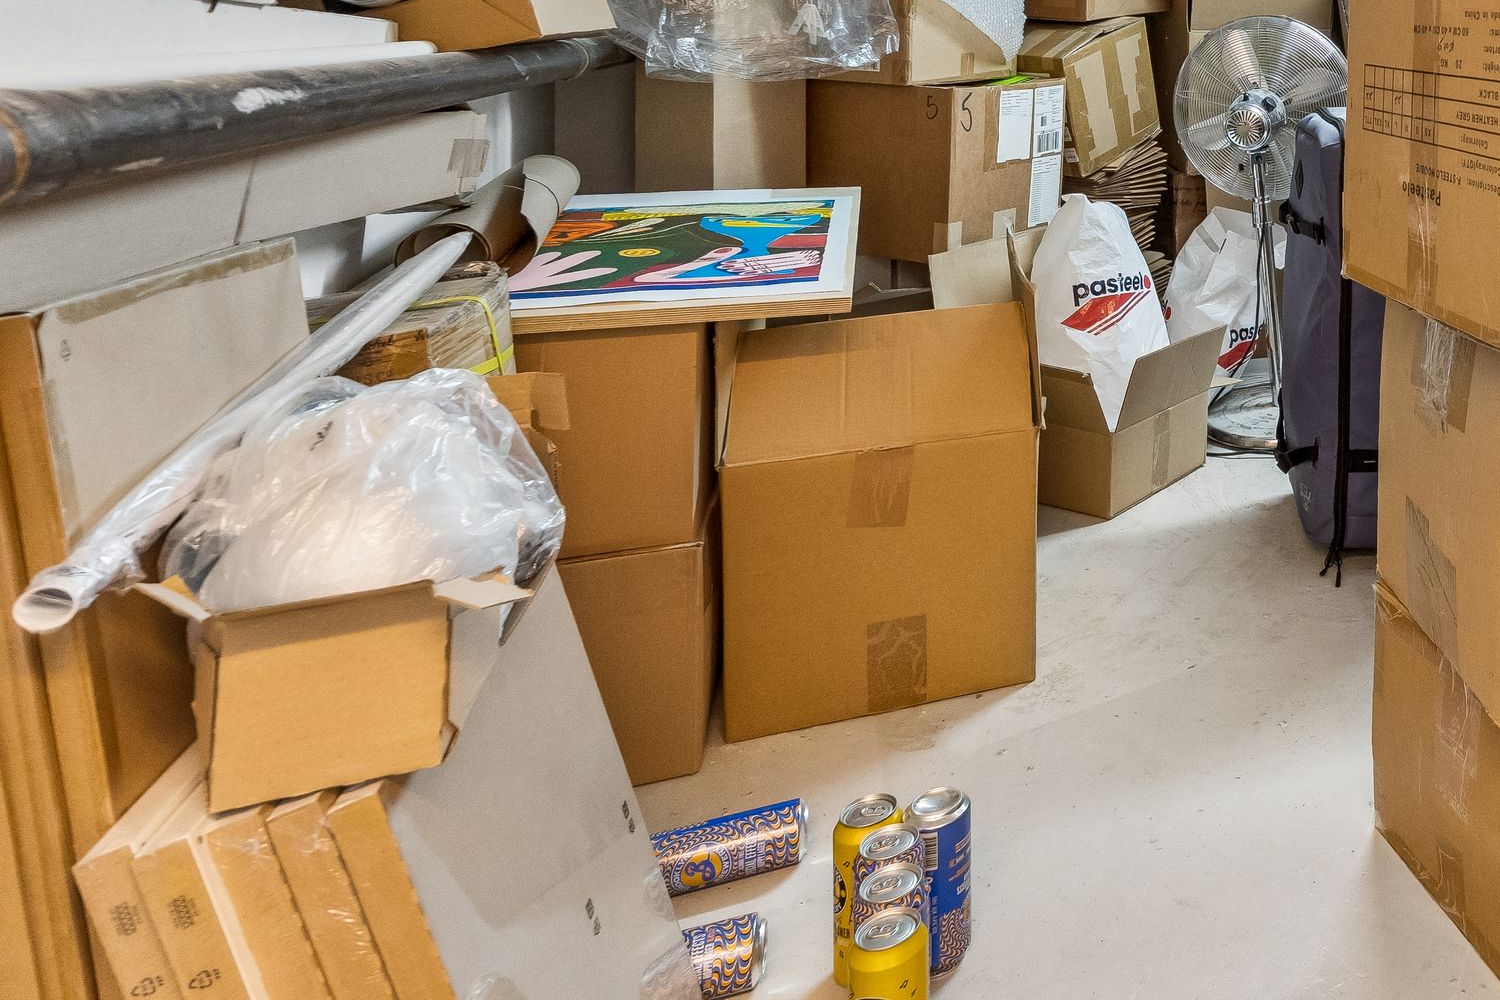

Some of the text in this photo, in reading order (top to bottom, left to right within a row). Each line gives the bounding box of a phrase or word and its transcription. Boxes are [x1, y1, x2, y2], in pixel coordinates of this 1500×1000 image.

[1464, 10, 1480, 20] China
[1440, 59, 1448, 68] KG
[1479, 89, 1498, 100] BLACK
[926, 95, 938, 119] 5
[960, 92, 972, 132] 5
[1456, 111, 1470, 121] GREY
[1471, 112, 1498, 126] HEATHER
[1460, 134, 1488, 149] Colorway:
[1402, 181, 1440, 206] Pasteelo
[1467, 178, 1500, 196] Description:
